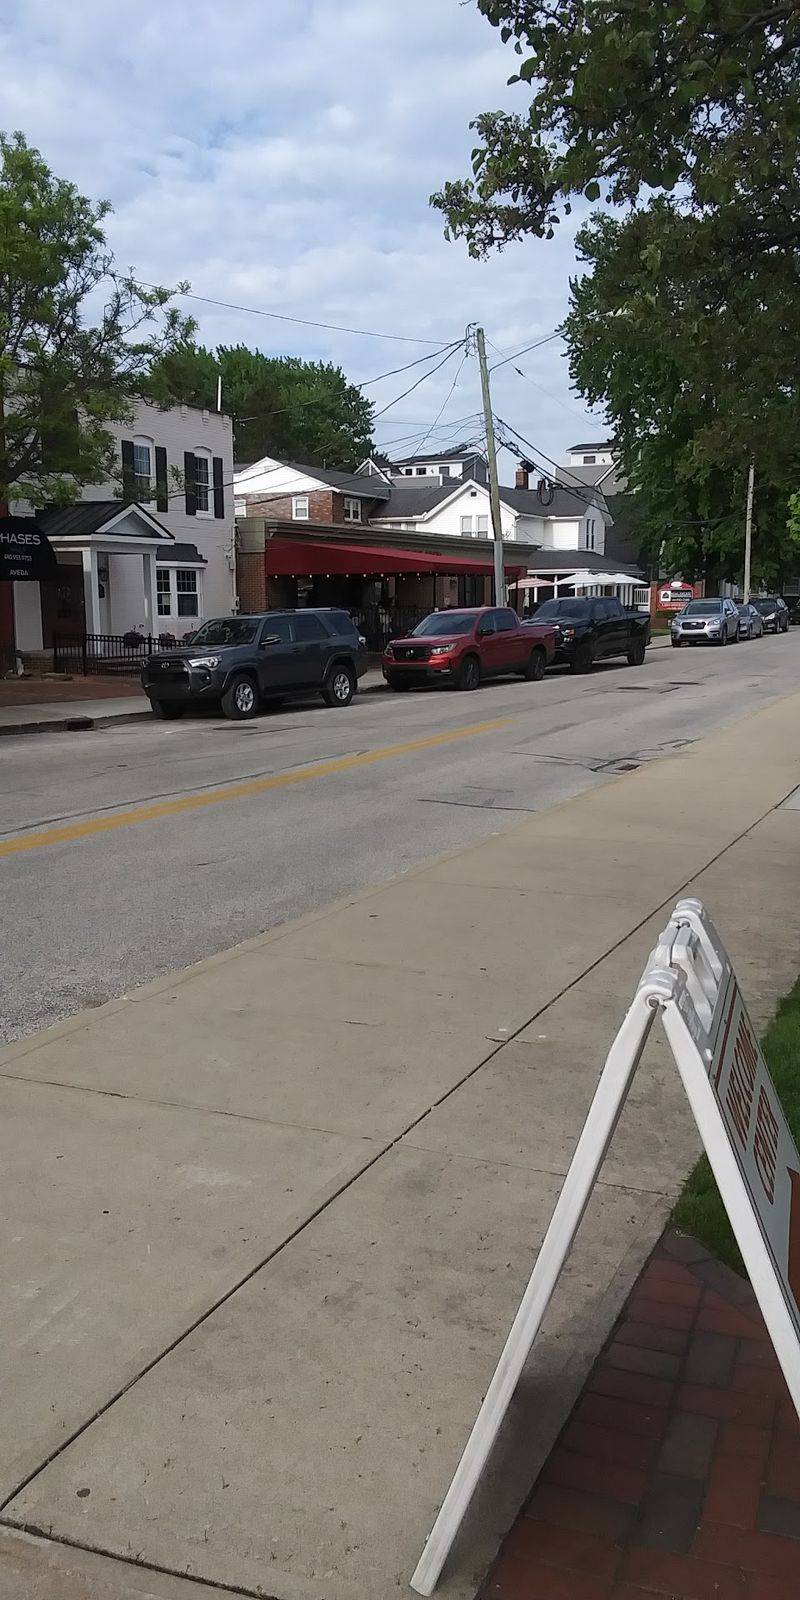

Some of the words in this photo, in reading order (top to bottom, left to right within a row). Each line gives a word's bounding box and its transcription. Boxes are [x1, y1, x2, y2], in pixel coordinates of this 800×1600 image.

[0, 533, 41, 545] HASES
[726, 1010, 758, 1152] WELCOME
[754, 1085, 779, 1205] CENTER
